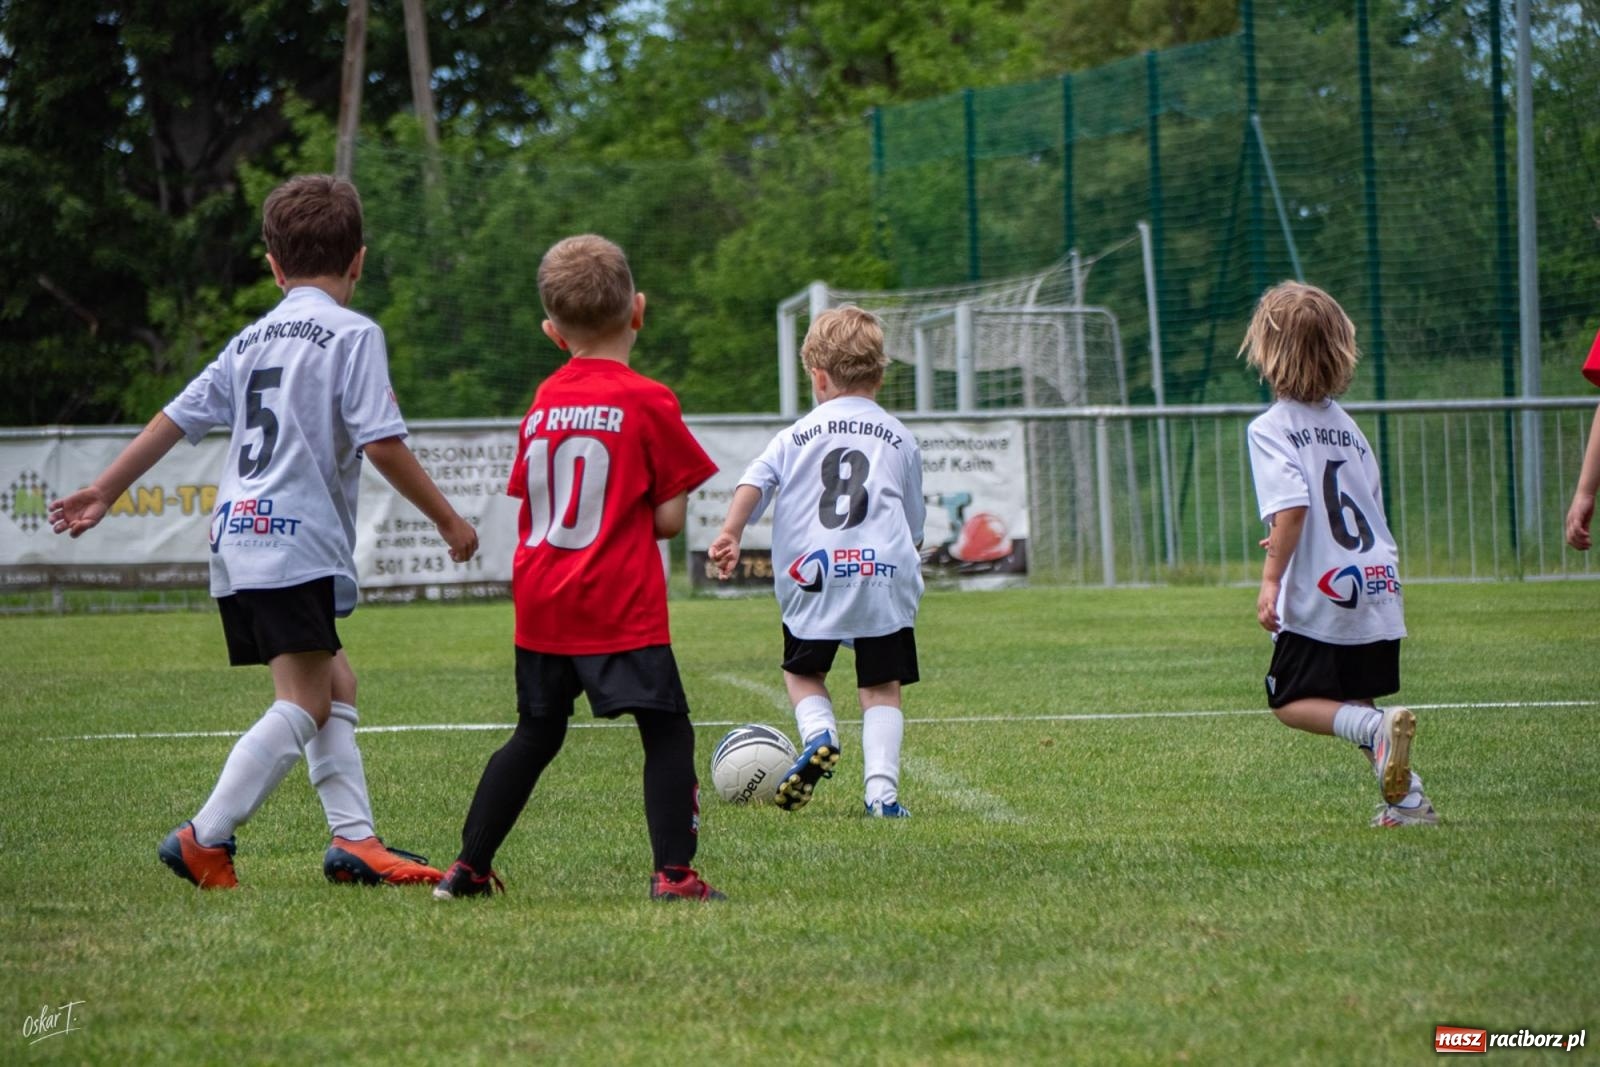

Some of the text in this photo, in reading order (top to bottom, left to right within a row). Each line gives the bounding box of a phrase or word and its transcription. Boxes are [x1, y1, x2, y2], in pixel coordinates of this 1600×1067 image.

[237, 318, 335, 355] UIA RACIBÓRZ
[238, 366, 284, 480] 5
[525, 405, 624, 439] AP RYMER
[792, 420, 903, 450] UNIA RACIBÓRZ
[1314, 427, 1366, 462] RACIB
[82, 484, 218, 516] AN-TR
[523, 436, 611, 550] 10
[818, 447, 871, 531] 8
[232, 499, 273, 516] PRO
[1323, 459, 1375, 553] 6
[228, 517, 301, 536] SPORT
[235, 540, 280, 548] ACTIVE
[834, 549, 875, 562] PRO
[834, 562, 897, 578] SPORT
[1364, 565, 1395, 580] PRO
[1367, 579, 1402, 596] SPOR
